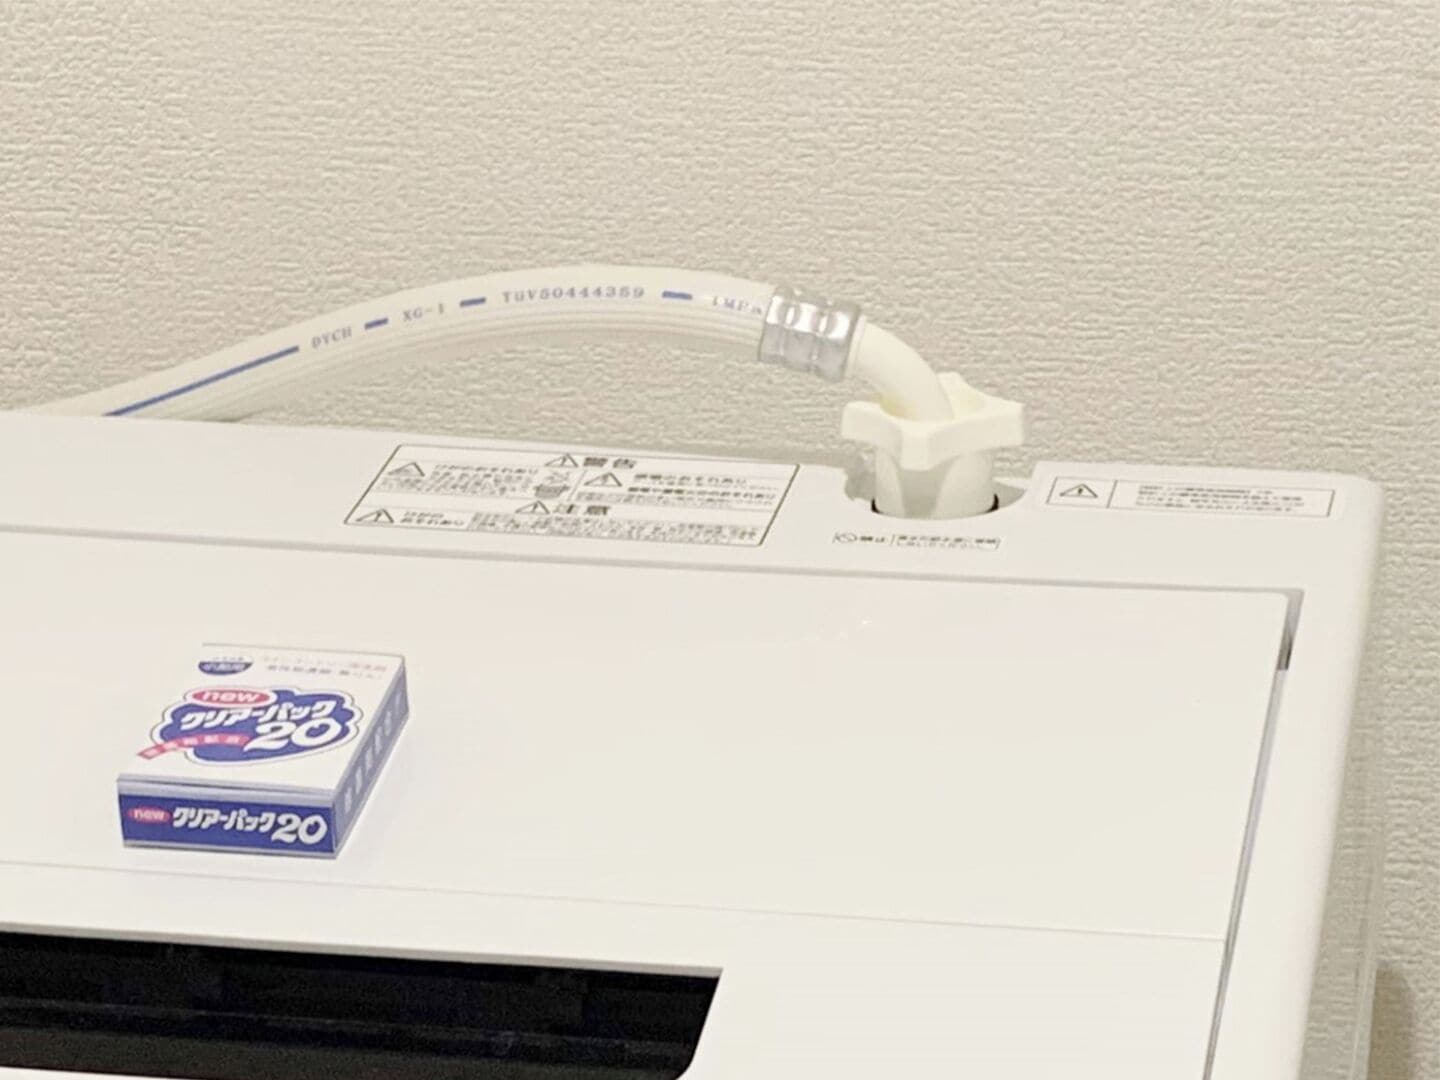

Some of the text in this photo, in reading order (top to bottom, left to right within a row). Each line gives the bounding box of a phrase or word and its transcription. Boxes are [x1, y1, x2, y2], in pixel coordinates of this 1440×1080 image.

[202, 690, 260, 703] new
[179, 699, 337, 731] クリアーパック
[243, 716, 343, 752] 20
[133, 806, 328, 844] new クリアーパック 20
